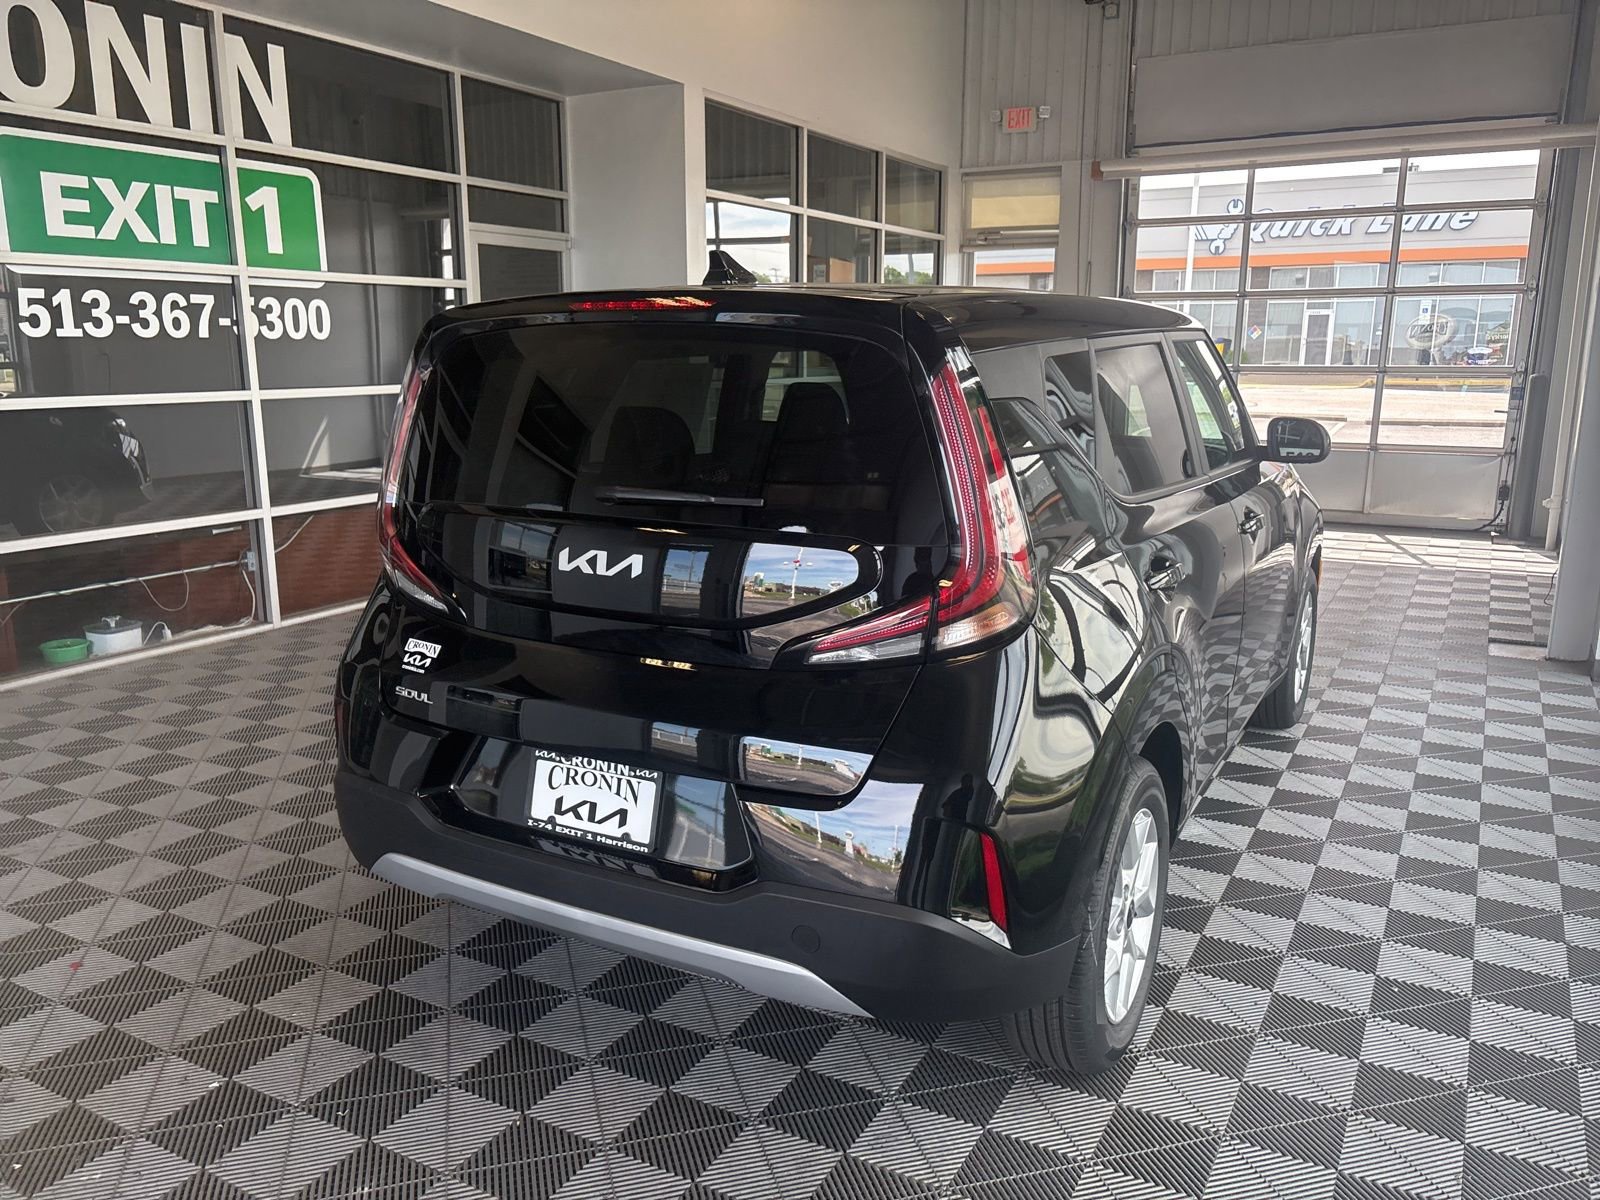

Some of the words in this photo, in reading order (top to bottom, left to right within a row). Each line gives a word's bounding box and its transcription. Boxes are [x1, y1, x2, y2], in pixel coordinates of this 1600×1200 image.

[1006, 107, 1032, 129] EXIT
[40, 171, 219, 247] EXIT
[244, 186, 283, 254] 1
[558, 547, 643, 578] KIA
[402, 653, 432, 668] KIA
[406, 640, 440, 657] CRONIN
[395, 685, 433, 704] SOUL
[560, 756, 629, 776] CRONIN
[547, 764, 642, 808] CRONIN
[554, 795, 628, 829] KIA
[527, 819, 552, 831] I-74
[555, 826, 583, 838] EXIT
[586, 833, 593, 841] 1
[597, 835, 648, 854] Harrison
